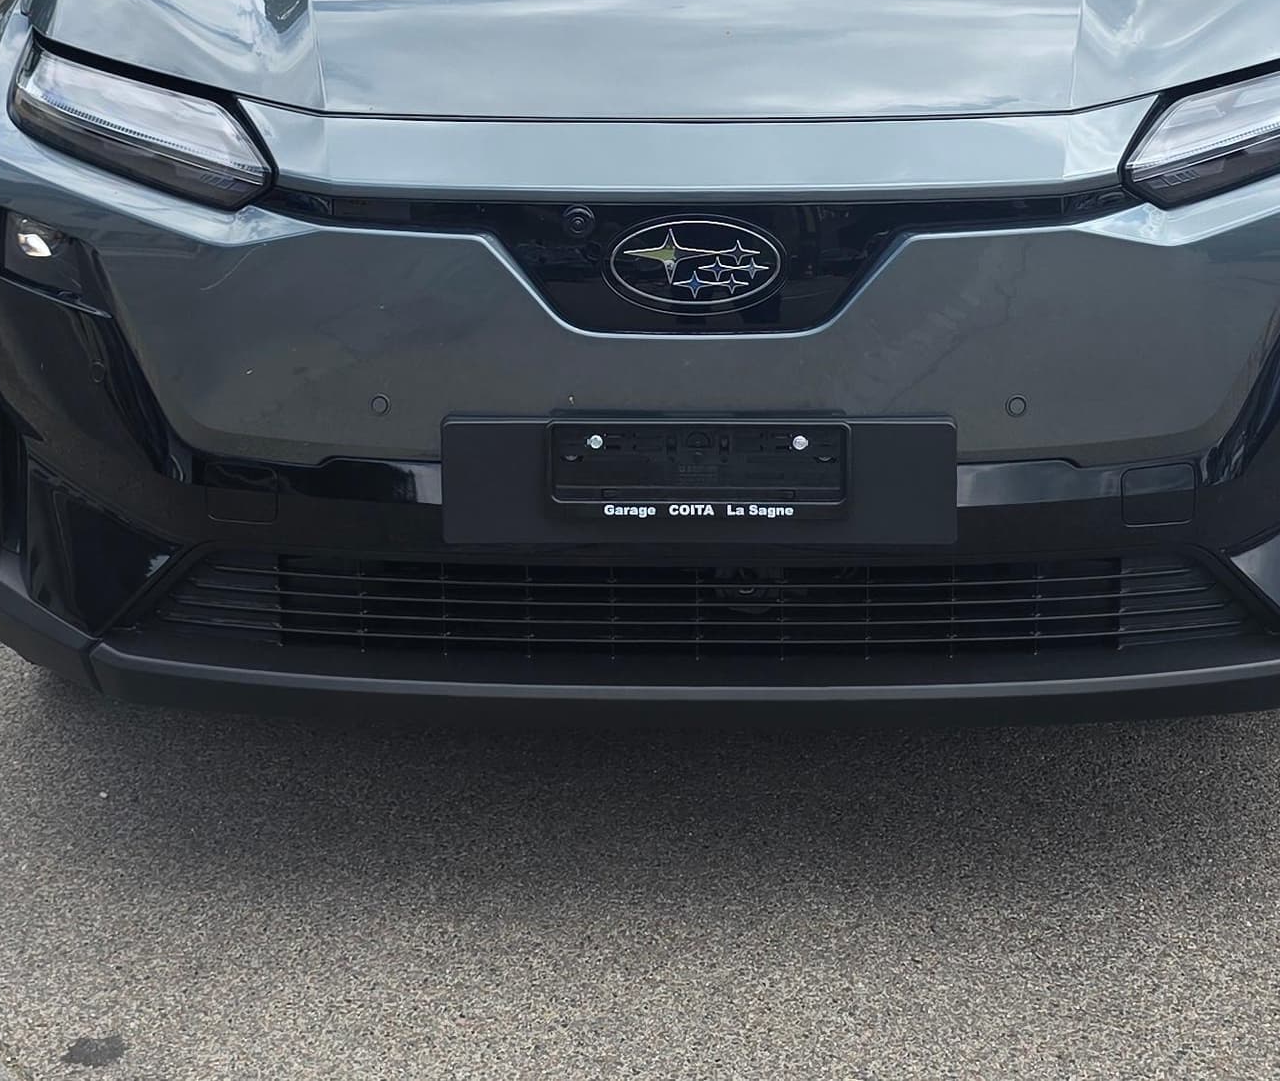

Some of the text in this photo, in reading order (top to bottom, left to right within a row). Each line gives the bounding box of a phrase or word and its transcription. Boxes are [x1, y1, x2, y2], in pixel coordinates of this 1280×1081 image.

[604, 504, 794, 518] Garage COITA La Sagne
